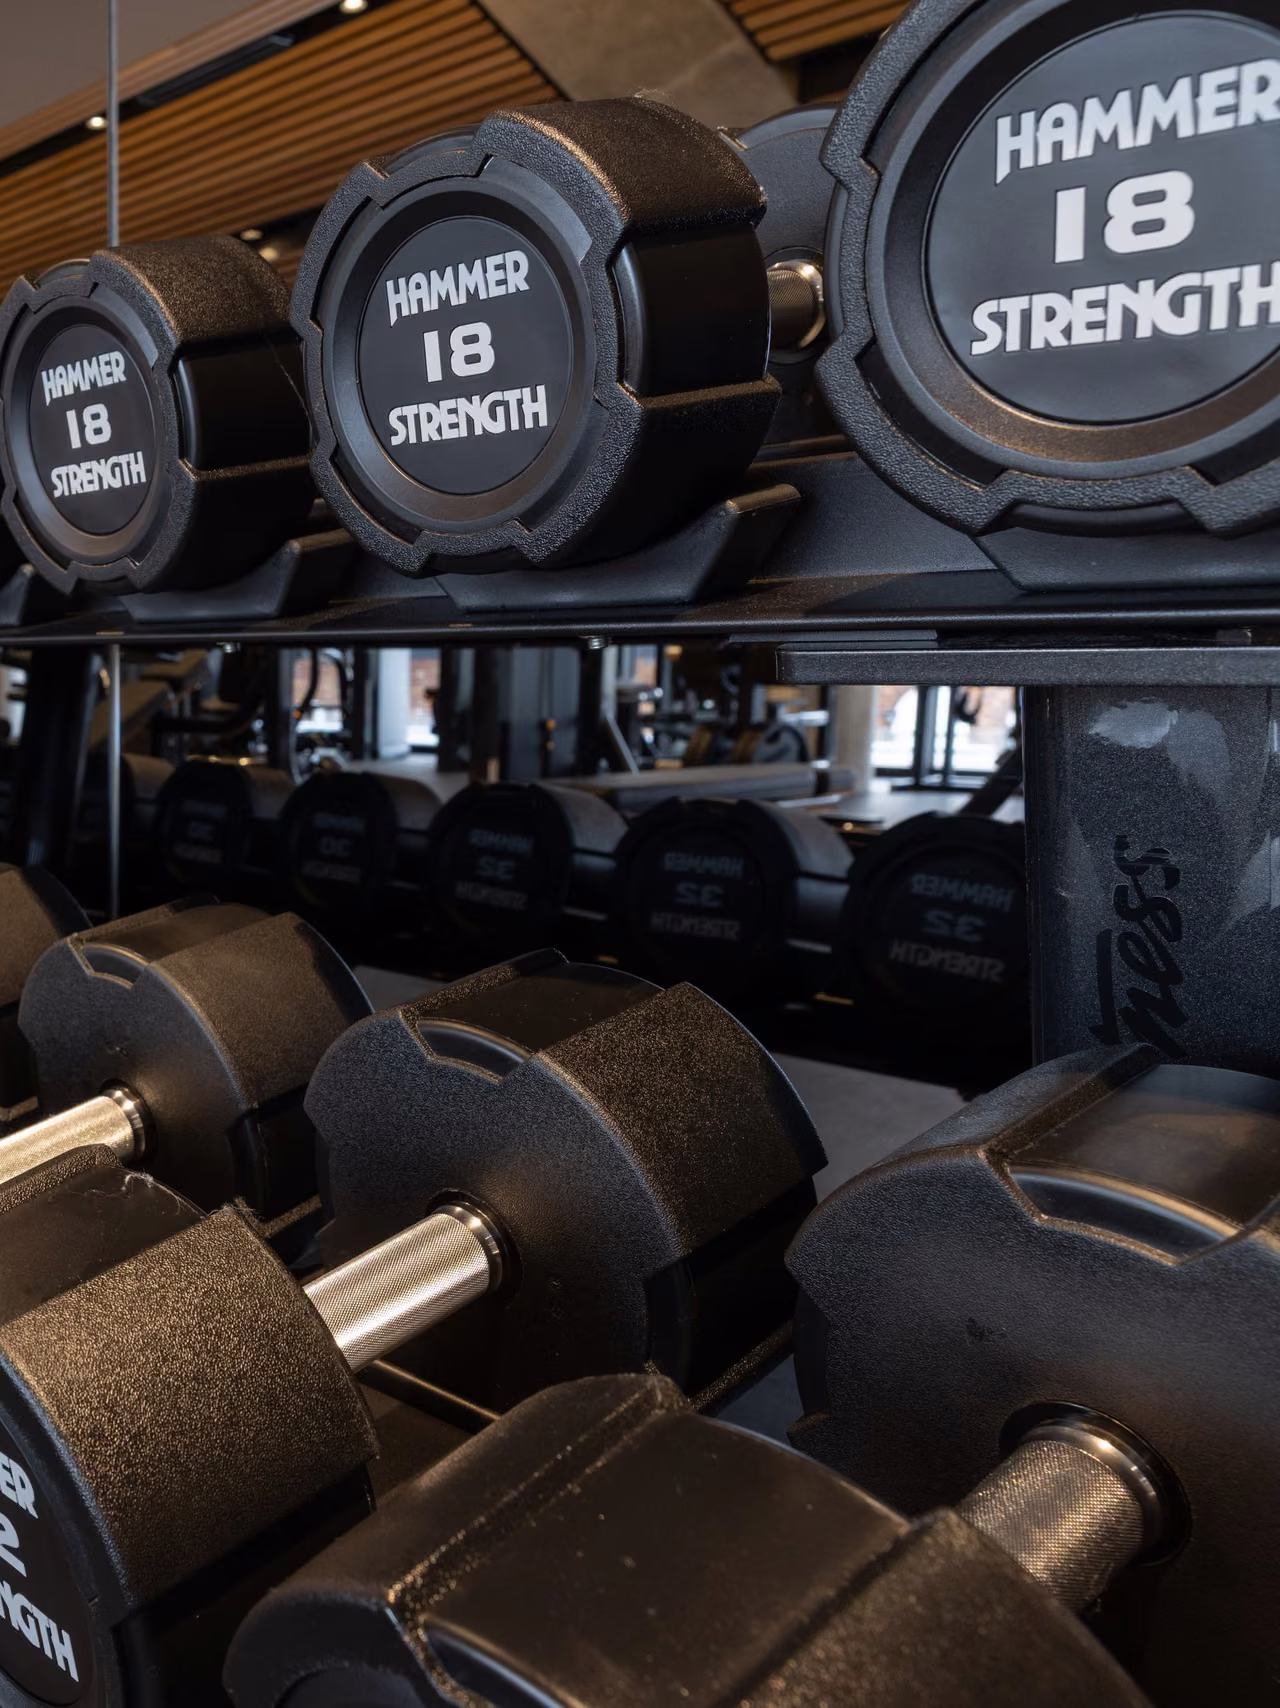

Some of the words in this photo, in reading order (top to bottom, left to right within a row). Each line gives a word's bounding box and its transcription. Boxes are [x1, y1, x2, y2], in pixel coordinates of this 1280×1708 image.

[996, 59, 1280, 184] HAMMER
[1054, 170, 1195, 264] 18
[386, 250, 530, 327] HAMMER
[971, 261, 1280, 355] STRENGTH
[41, 350, 127, 407] HAMMER
[423, 321, 496, 383] 18
[65, 403, 112, 449] 18
[388, 384, 548, 446] STRENGTH
[50, 451, 147, 498] STRENGTH
[1089, 835, 1188, 1058] ness
